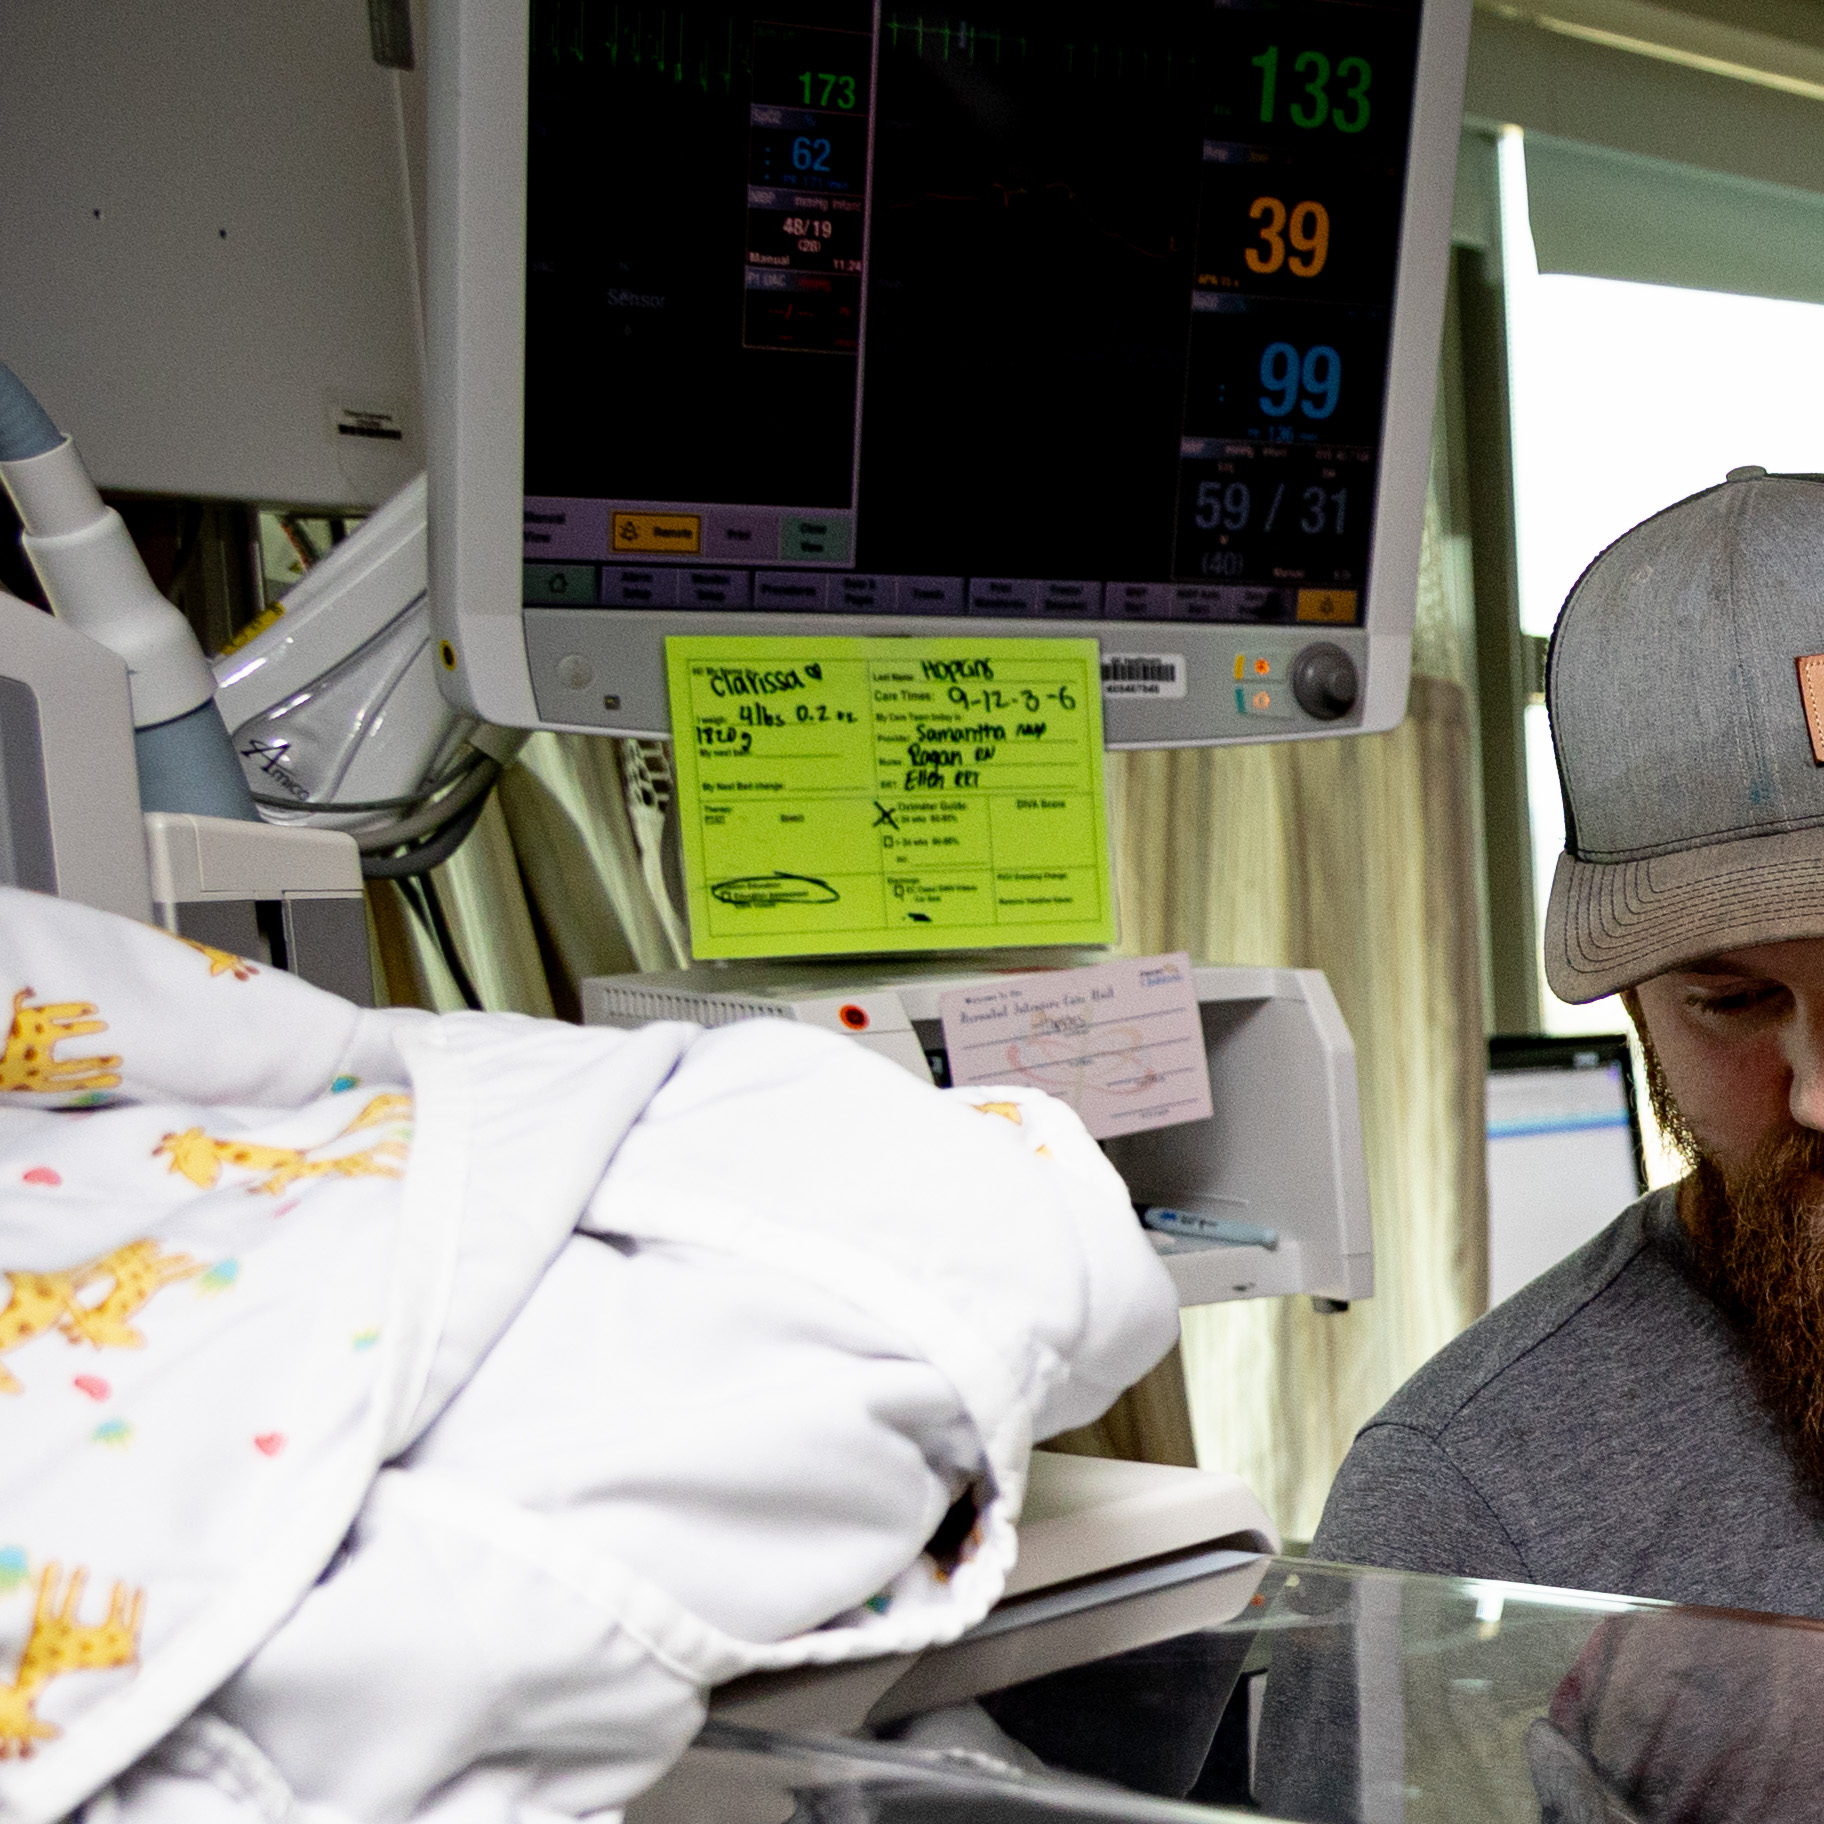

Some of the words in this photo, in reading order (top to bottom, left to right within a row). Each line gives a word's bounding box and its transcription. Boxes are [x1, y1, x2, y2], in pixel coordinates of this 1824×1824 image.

[798, 71, 856, 109] 173
[1251, 44, 1373, 134] 133
[792, 136, 831, 172] 62
[782, 216, 832, 239] 48/19
[1244, 196, 1330, 278] 39
[749, 251, 790, 266] Manual
[1258, 341, 1342, 420] 99
[1193, 480, 1251, 532] 59
[1263, 482, 1287, 534] /
[1300, 484, 1348, 536] 31
[1201, 551, 1245, 577] (40)
[710, 670, 806, 698] Clarissa
[875, 690, 898, 702] Care
[916, 722, 1007, 743] Samantha
[240, 738, 310, 802] Amico
